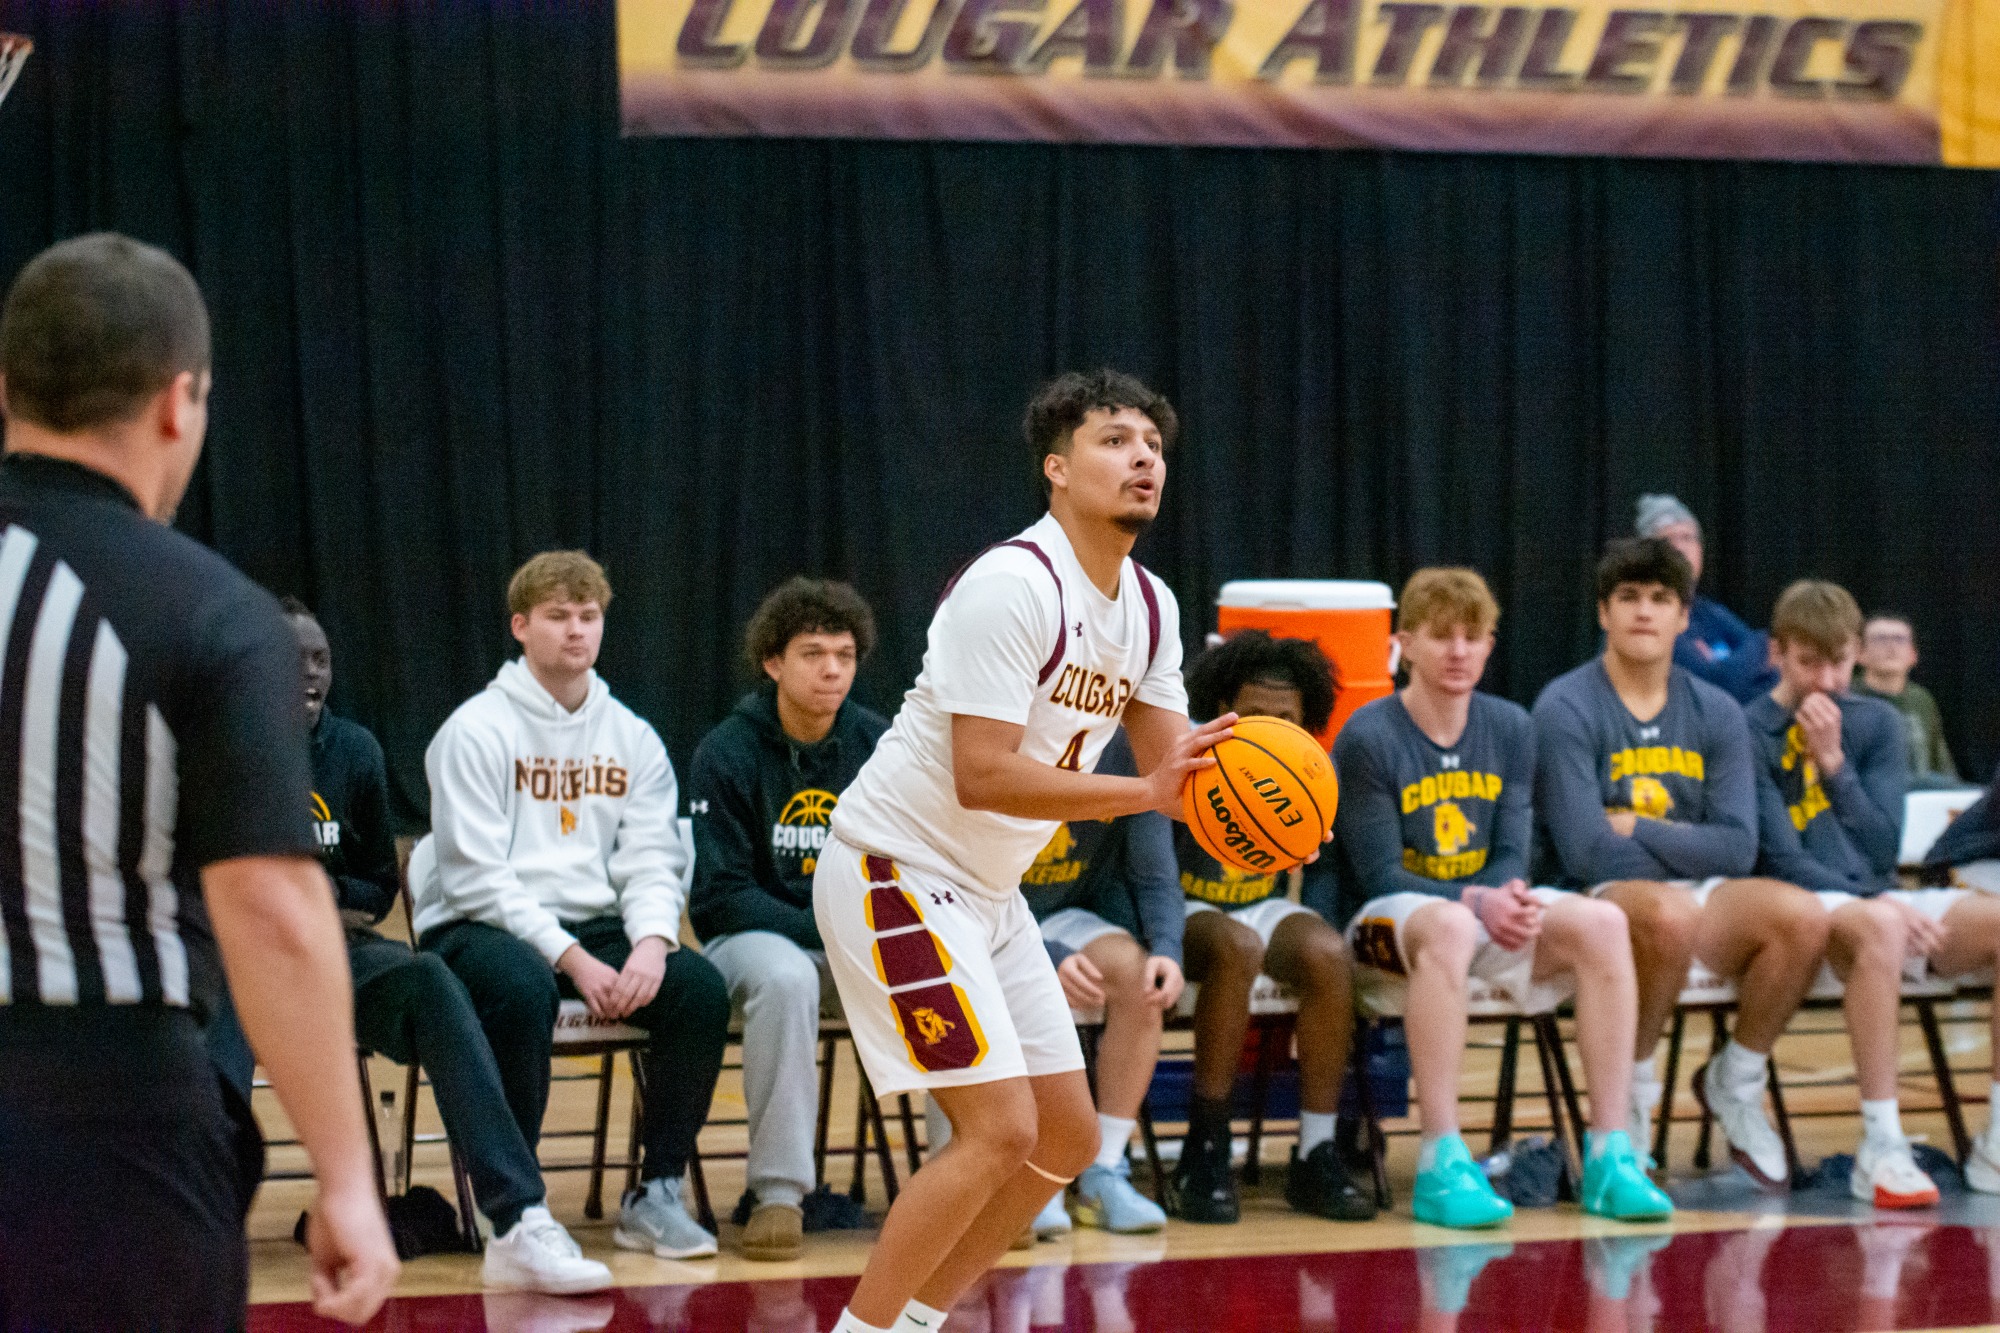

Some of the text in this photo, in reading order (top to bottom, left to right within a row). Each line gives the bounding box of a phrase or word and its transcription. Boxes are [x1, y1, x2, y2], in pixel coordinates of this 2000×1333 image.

[676, 0, 1922, 100] COUGAR ATHLETICS
[1056, 728, 1090, 772] 4
[1401, 770, 1503, 815] COUGAR
[772, 821, 833, 850] COUG
[1207, 785, 1277, 869] Wilson
